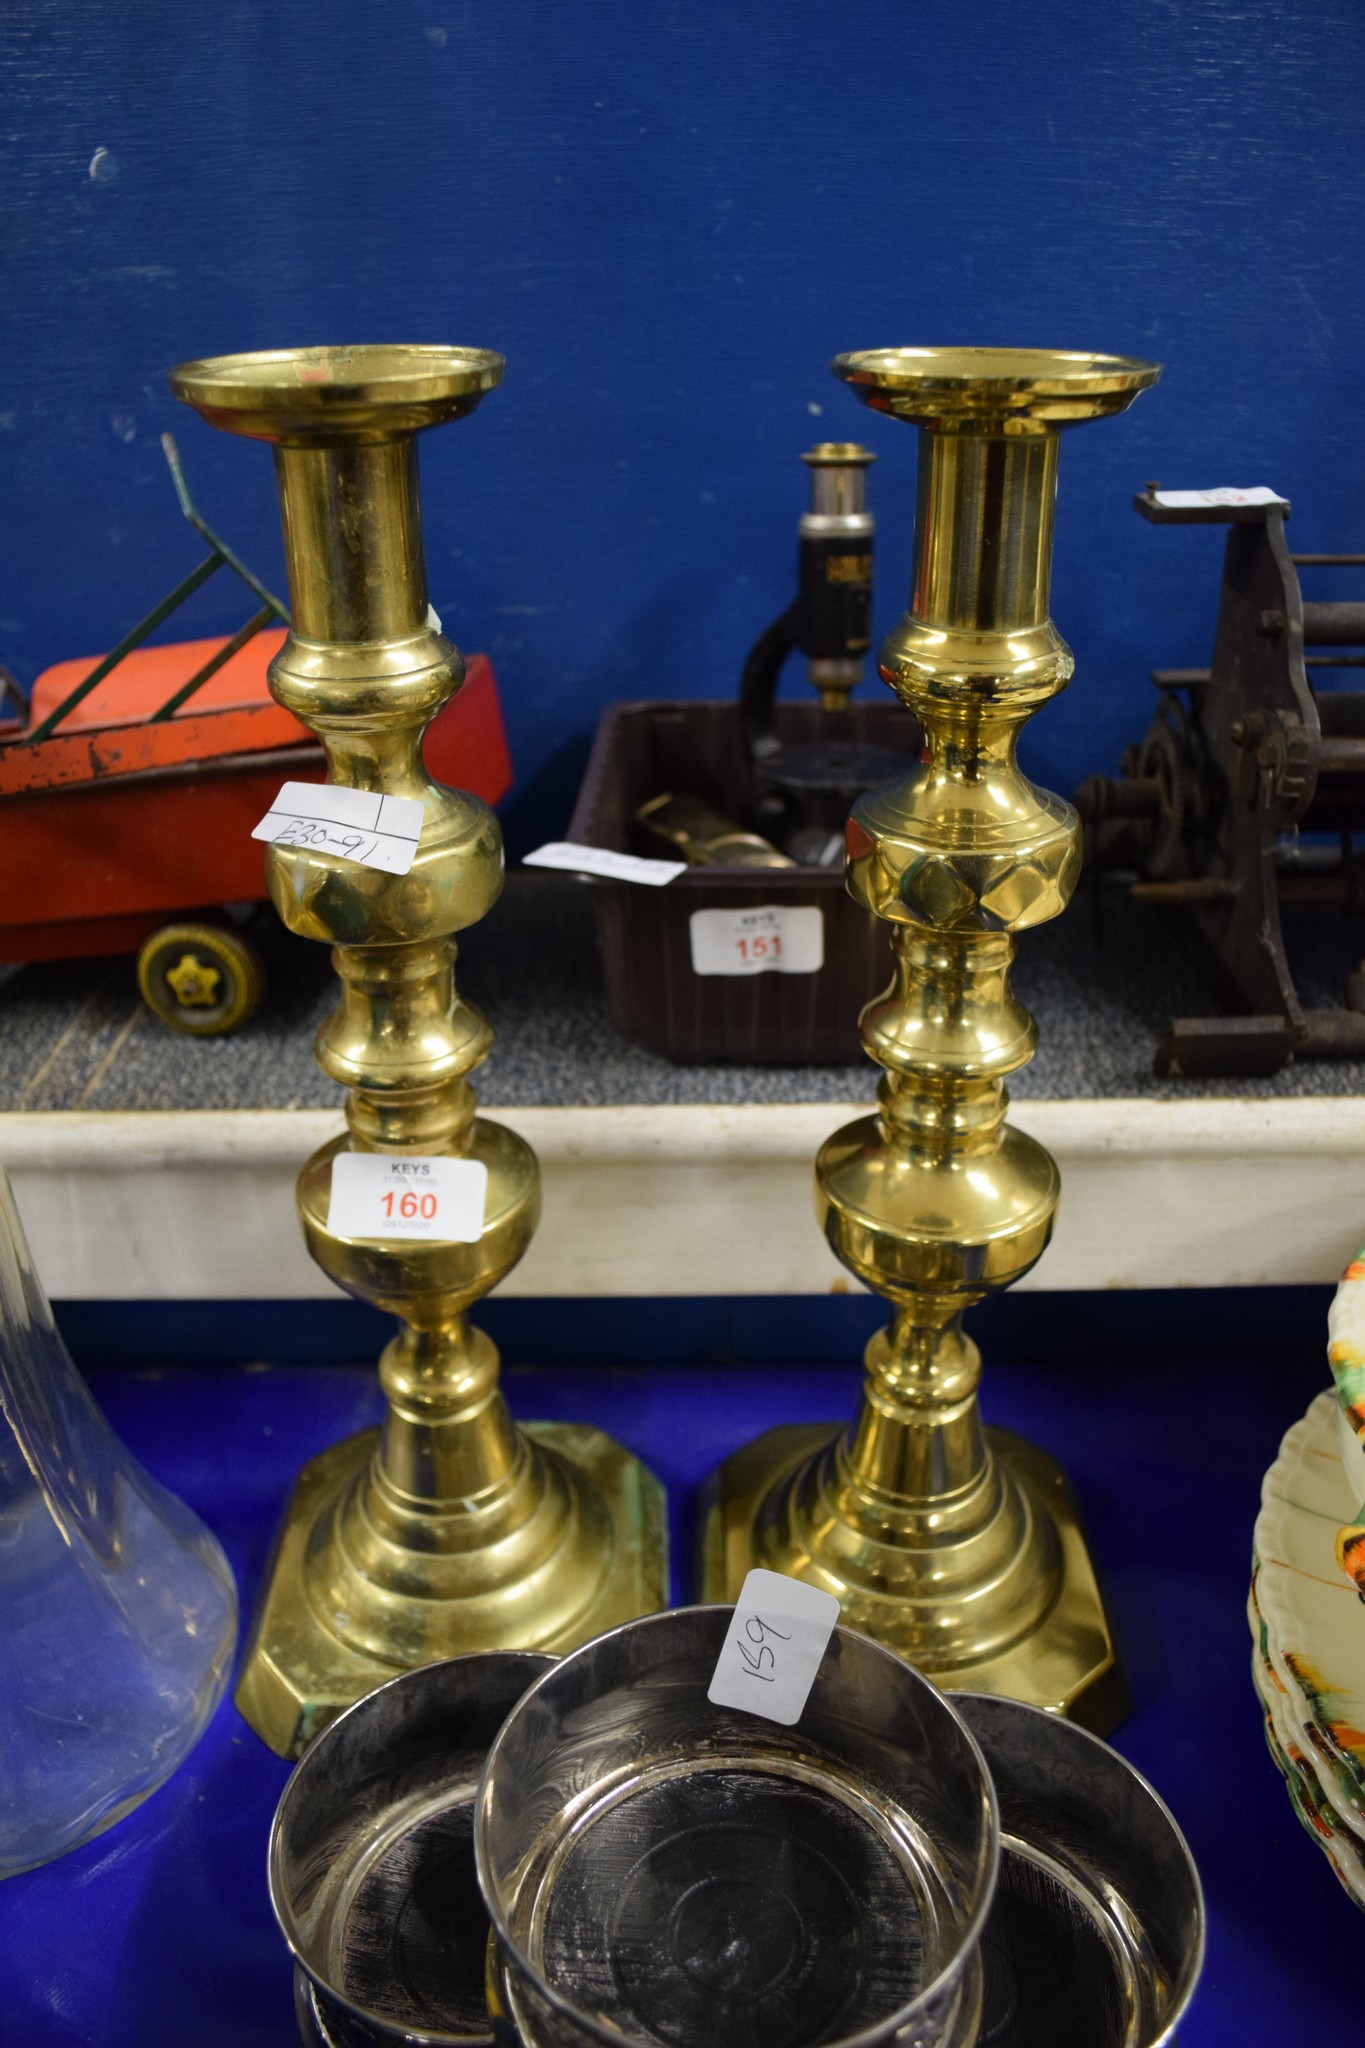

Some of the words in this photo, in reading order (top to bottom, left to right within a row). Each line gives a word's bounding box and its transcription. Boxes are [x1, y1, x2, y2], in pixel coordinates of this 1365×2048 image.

[736, 935, 782, 961] 151
[391, 1162, 431, 1176] KEYS
[380, 1190, 438, 1220] 160
